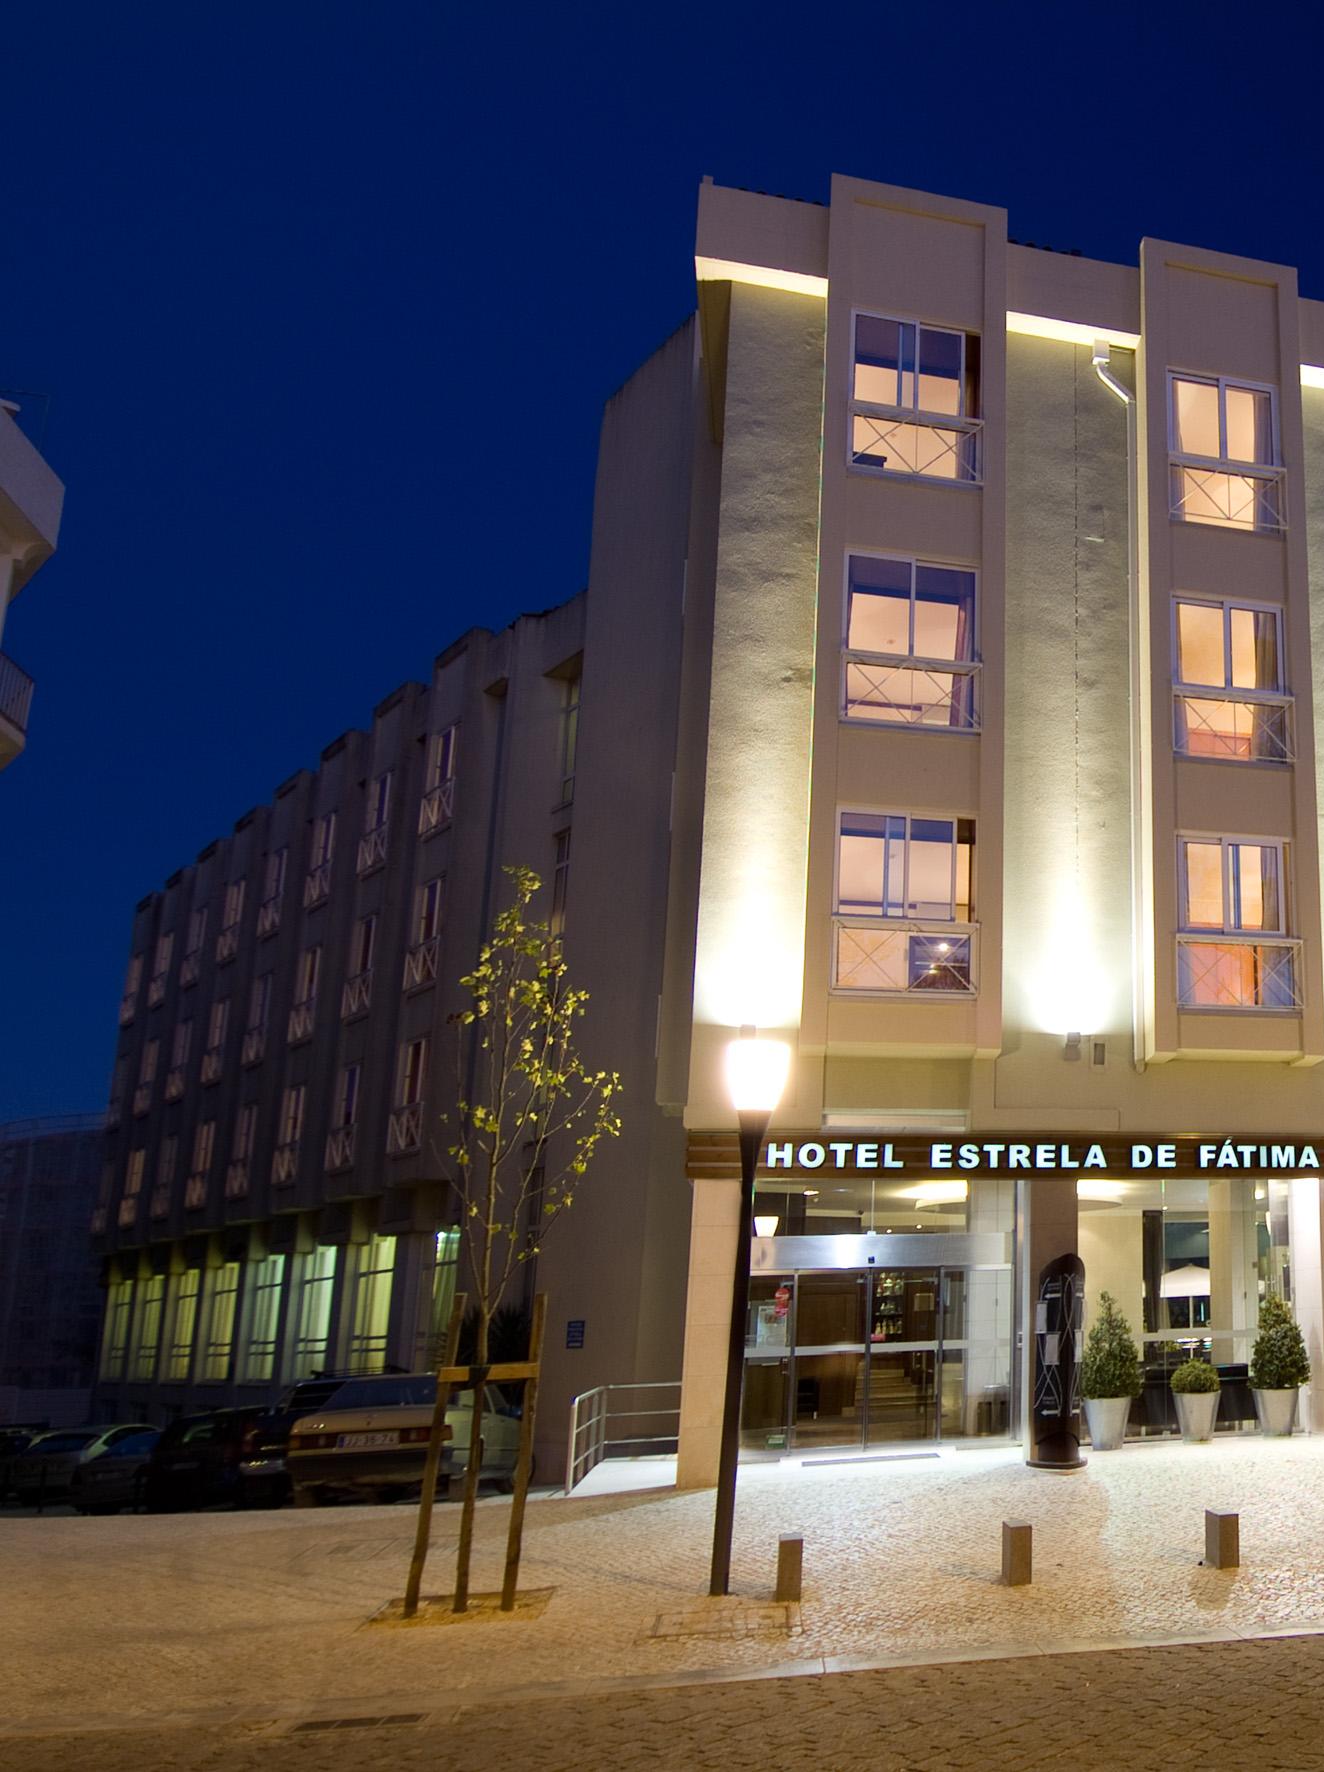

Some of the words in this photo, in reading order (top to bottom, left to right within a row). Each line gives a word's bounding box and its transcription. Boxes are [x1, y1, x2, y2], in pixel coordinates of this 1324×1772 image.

[766, 1143, 904, 1168] HOTEL
[930, 1143, 1107, 1168] ESTRELA
[1131, 1144, 1176, 1168] DE
[1199, 1138, 1320, 1168] FÁTIMA
